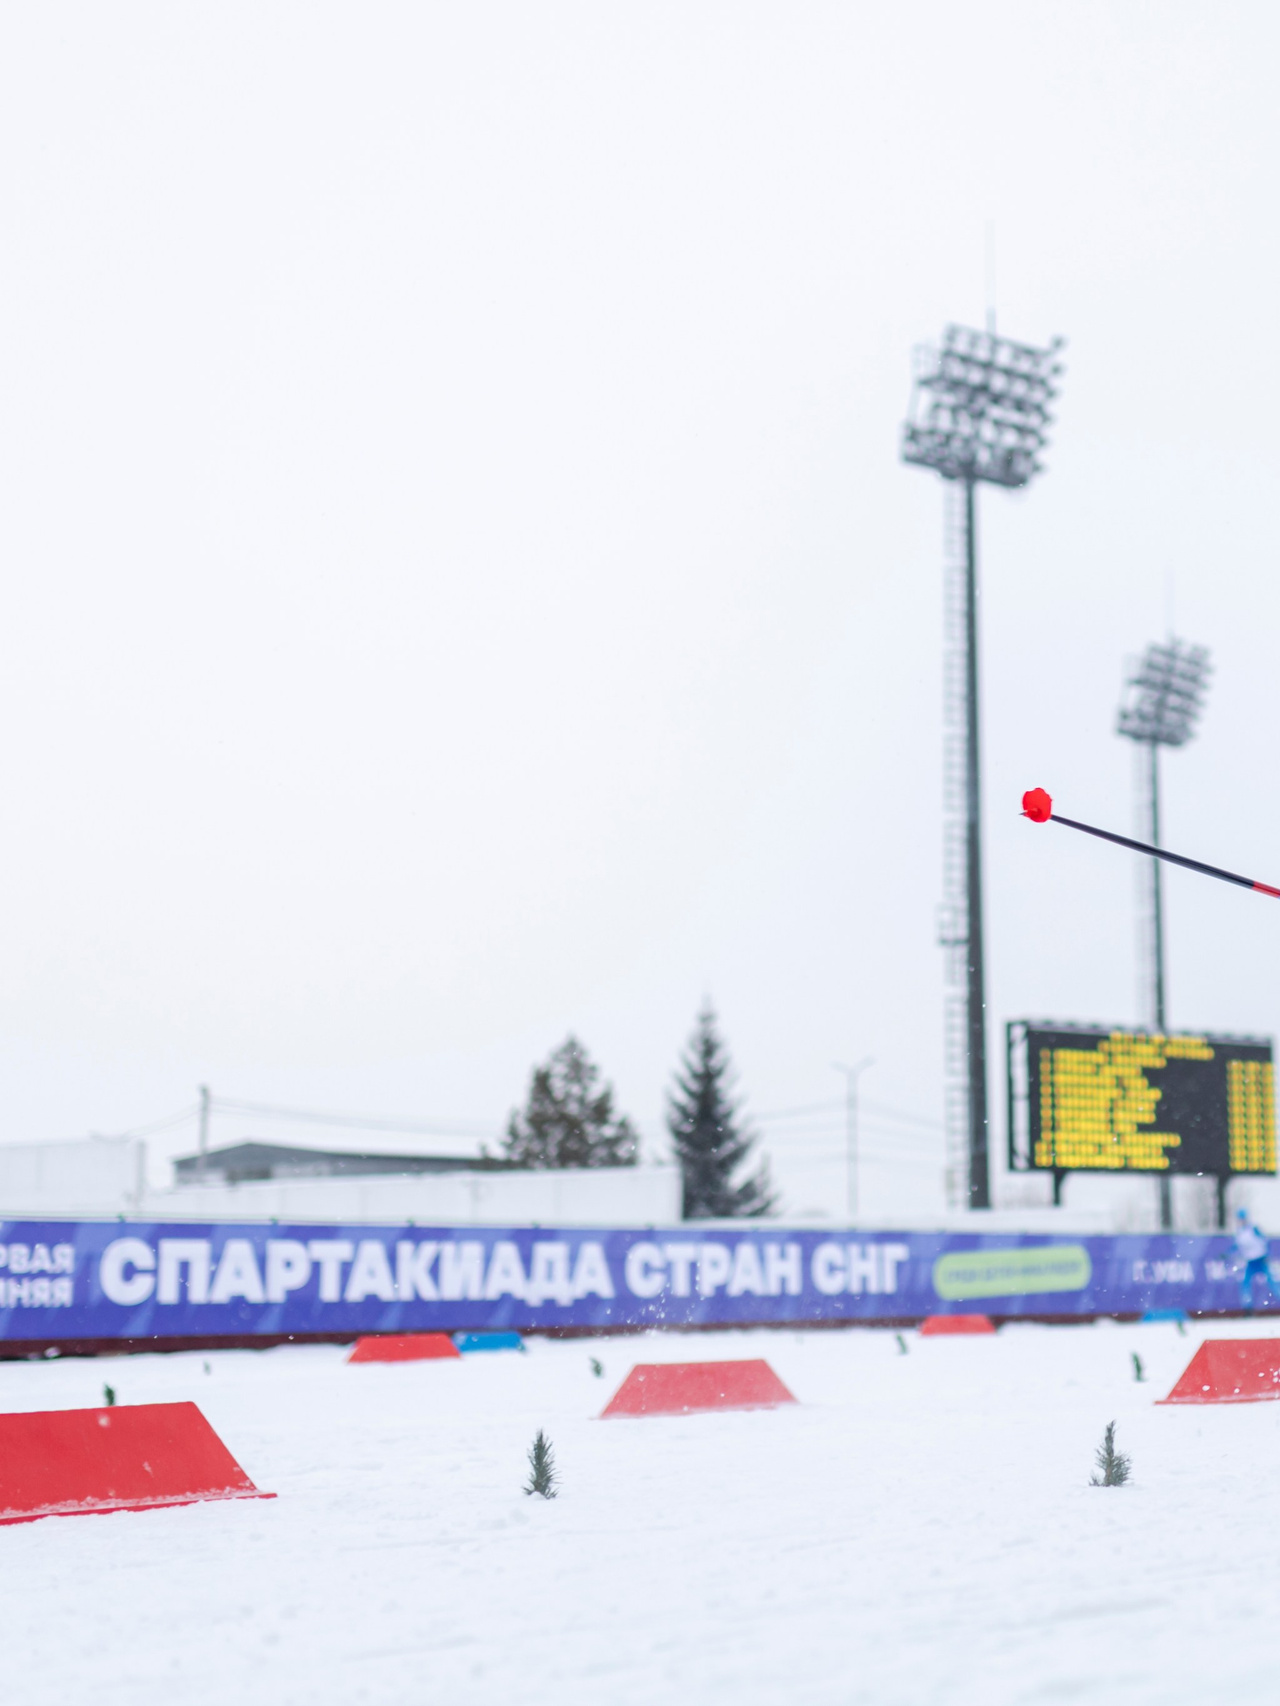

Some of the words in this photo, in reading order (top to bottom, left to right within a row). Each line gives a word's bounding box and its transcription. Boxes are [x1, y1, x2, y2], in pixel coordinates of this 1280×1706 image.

[99, 1236, 614, 1307] СПАРТАКИАДА
[625, 1240, 804, 1299] СТРАН
[813, 1241, 909, 1296] СНГ
